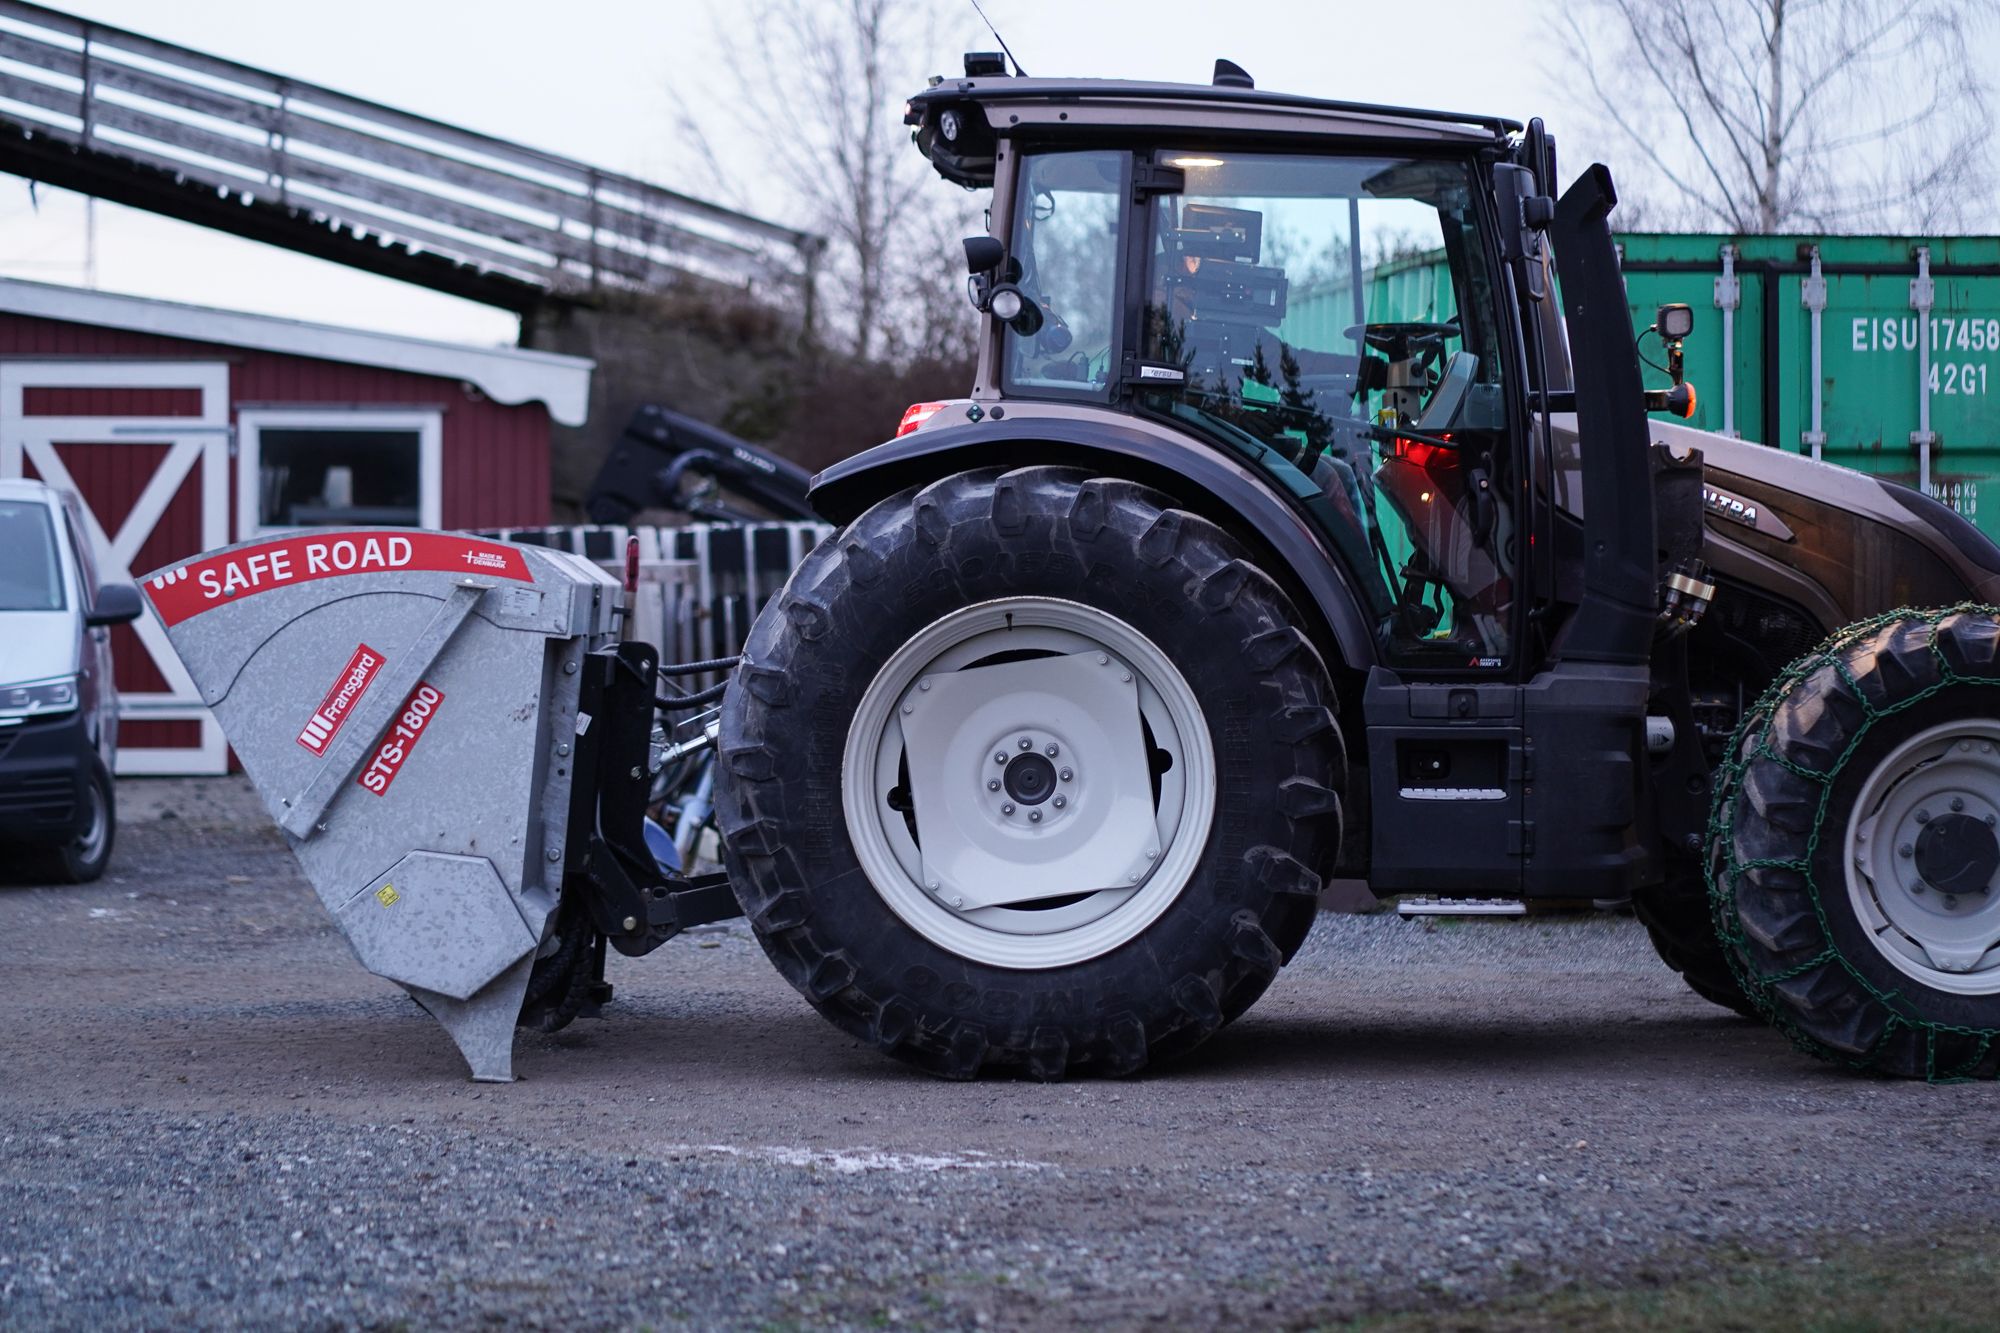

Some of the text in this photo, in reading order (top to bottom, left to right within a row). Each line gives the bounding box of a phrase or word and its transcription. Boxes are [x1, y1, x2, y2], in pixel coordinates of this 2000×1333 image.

[1852, 317, 2000, 352] EISU 17458
[1928, 362, 1987, 395] 42G1
[199, 537, 413, 599] SAFE ROAD
[473, 558, 507, 569] DENMARK
[478, 552, 495, 561] MADE
[324, 653, 376, 722] Fransgård
[363, 686, 439, 791] STS-1800
